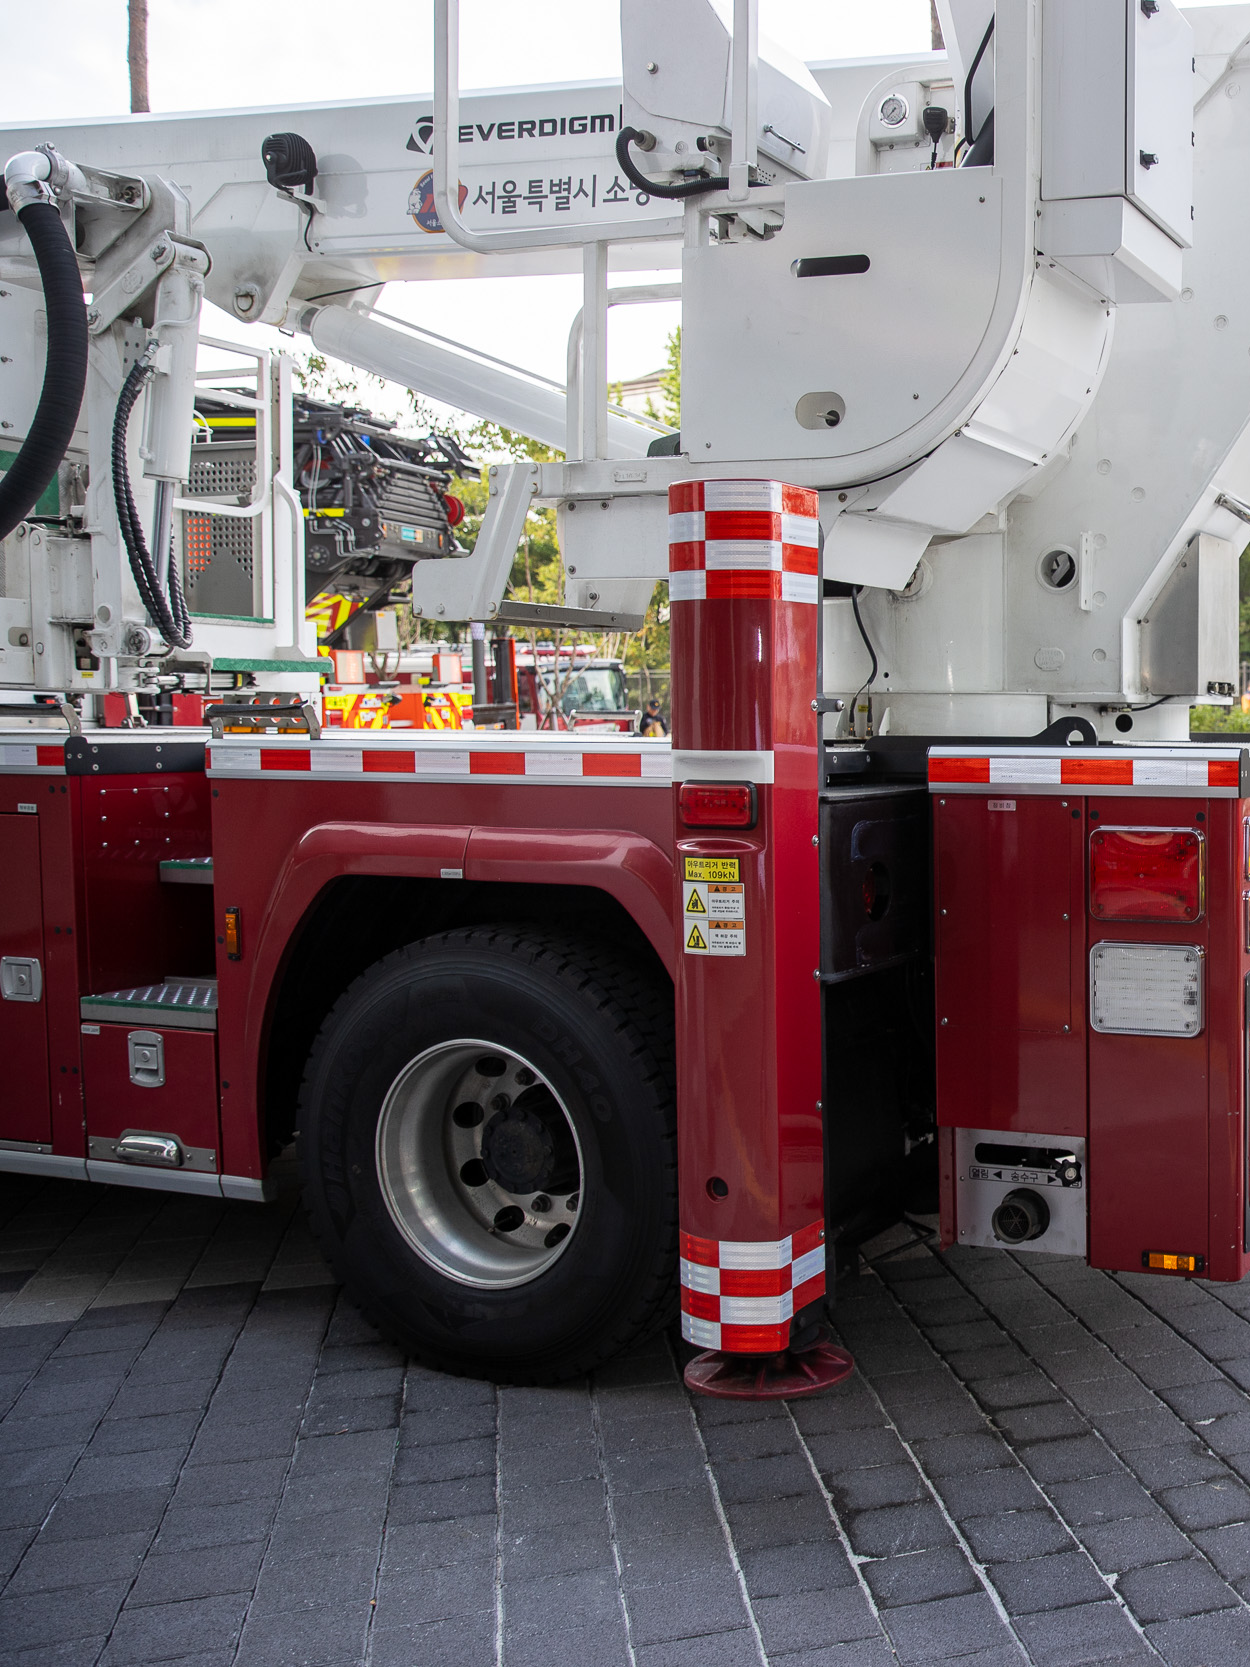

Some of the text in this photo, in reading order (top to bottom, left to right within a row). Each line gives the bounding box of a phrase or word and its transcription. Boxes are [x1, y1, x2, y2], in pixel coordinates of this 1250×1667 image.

[459, 113, 614, 143] EVERDIGM
[472, 174, 597, 215] 서울특별시
[687, 860, 718, 869] 아우트리거
[688, 870, 735, 879] Max. 109kN
[1010, 1171, 1038, 1183] 송수구
